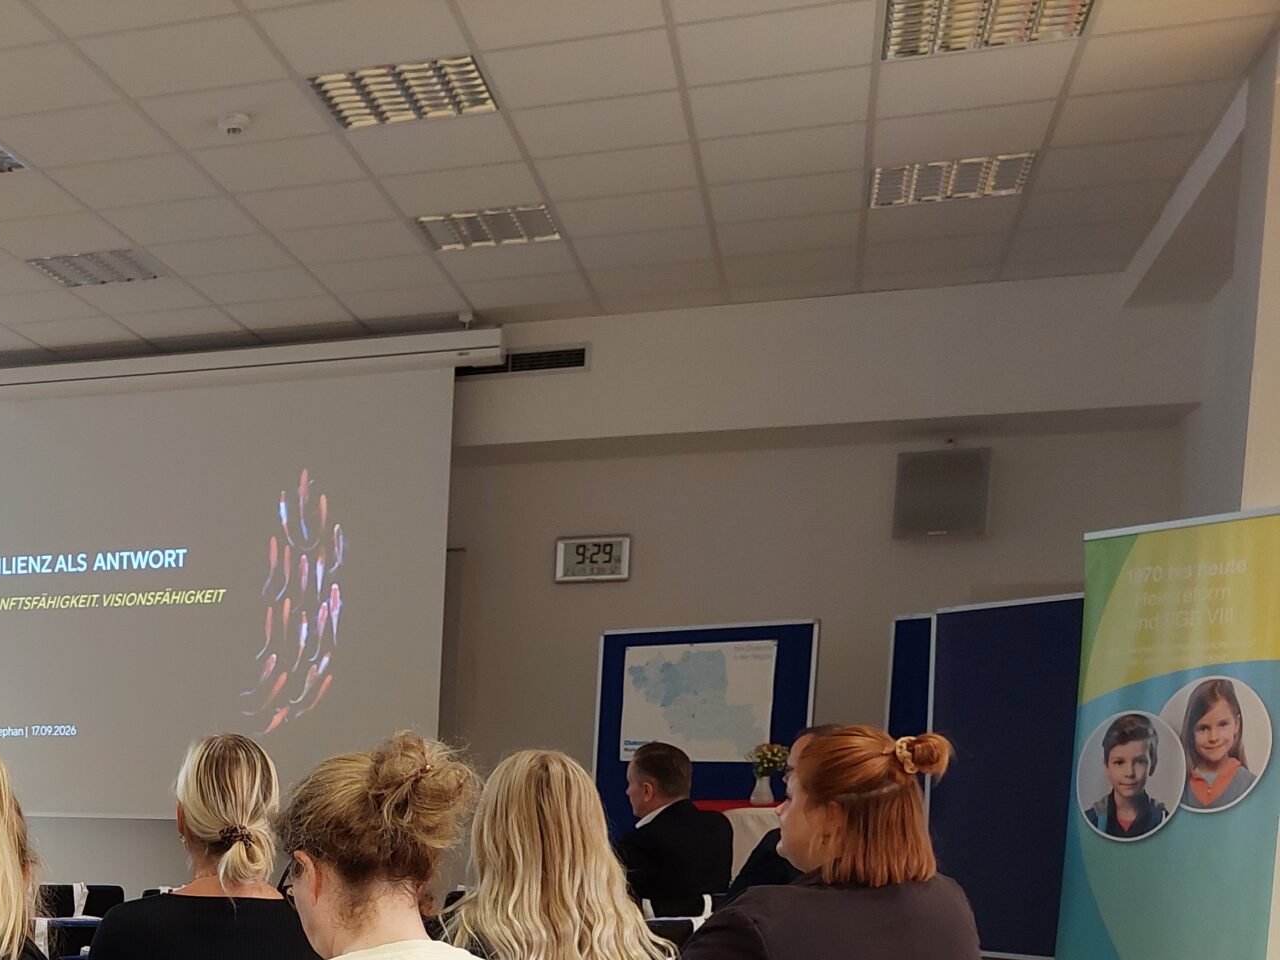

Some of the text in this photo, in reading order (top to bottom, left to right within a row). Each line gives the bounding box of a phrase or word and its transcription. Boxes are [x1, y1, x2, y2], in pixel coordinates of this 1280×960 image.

[55, 553, 87, 573] ALS
[93, 549, 187, 571] ANTWORT
[575, 543, 613, 565] 9:29
[102, 588, 226, 607] VISIONSFÄHIGKEIT
